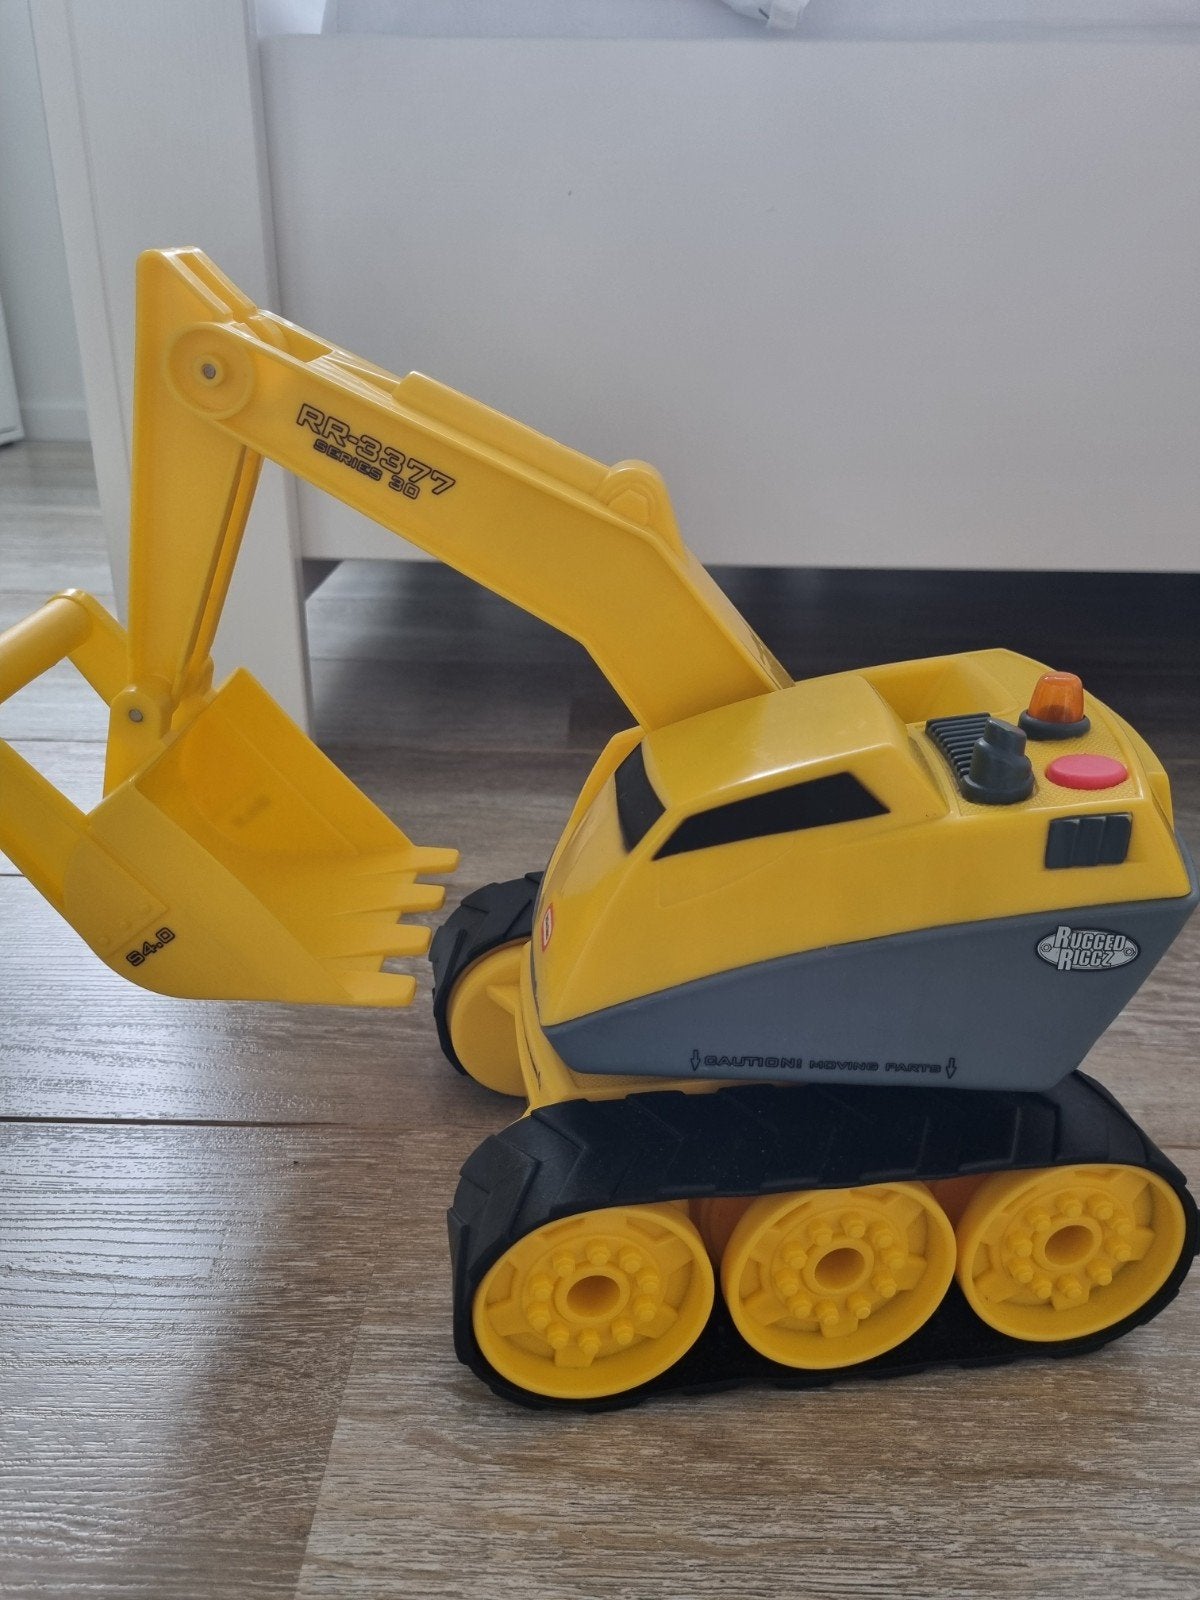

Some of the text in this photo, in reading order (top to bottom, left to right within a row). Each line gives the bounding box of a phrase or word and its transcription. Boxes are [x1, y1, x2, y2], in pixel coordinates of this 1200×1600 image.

[297, 403, 456, 495] RR-3377
[313, 438, 420, 500] SERIES 30
[126, 927, 175, 967] S4.0
[1053, 926, 1126, 951] RUGGED
[1057, 948, 1115, 970] RIGGZ
[704, 1055, 942, 1073] CAUTION! MOVING PARTS
